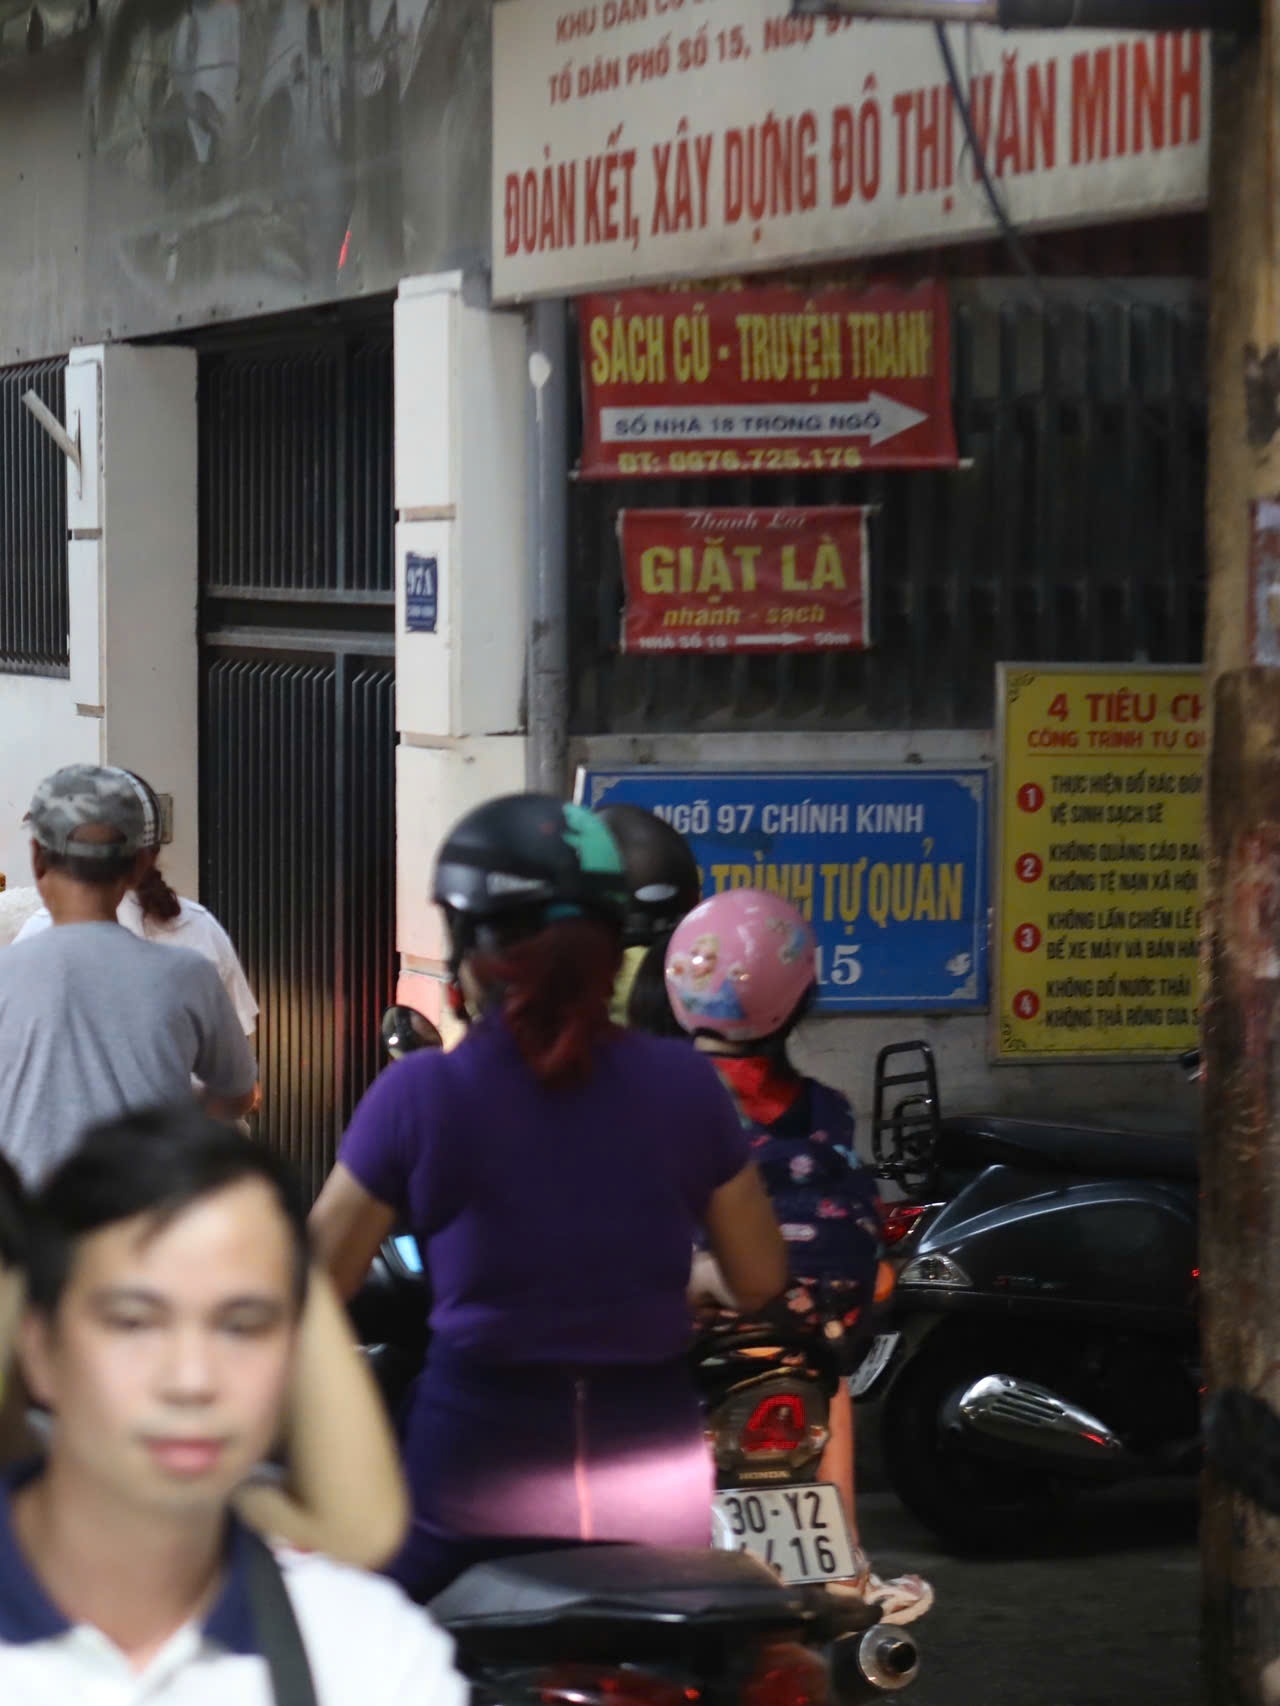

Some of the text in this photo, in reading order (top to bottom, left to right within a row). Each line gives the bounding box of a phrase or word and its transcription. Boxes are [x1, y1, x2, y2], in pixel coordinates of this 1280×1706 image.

[556, 5, 597, 43] KHU
[626, 29, 673, 85] PHỐ
[678, 18, 710, 70] SỐ
[584, 119, 641, 253] KẾT,
[651, 115, 714, 236] XÂY
[724, 109, 818, 245] DỰNG
[830, 71, 881, 210] ĐÔ
[892, 79, 955, 214] THỊ
[969, 48, 1057, 182] VĂN
[1070, 31, 1202, 167] MINH
[590, 301, 666, 385] SÁCH
[673, 302, 711, 384] CŨ
[735, 298, 842, 396] TRUYỆN
[616, 412, 648, 436] SỐ
[742, 414, 821, 433] TRONG
[829, 409, 882, 431] NGÕ
[640, 533, 847, 604] GIẶT LÀ
[663, 604, 742, 627] nhanh
[1048, 693, 1068, 722] 4
[1085, 686, 1157, 723] TIÊU
[1027, 728, 1079, 748] CÔNG
[1088, 728, 1144, 748] TRÌNH
[1025, 788, 1035, 808] 1
[653, 798, 924, 835] NGÕ 97 CHÍNH KINH
[1049, 840, 1096, 862] KHÔNG
[1149, 839, 1178, 862] CÁO
[1022, 857, 1036, 878] 2
[820, 857, 869, 935] TỰ
[869, 838, 964, 928] QUẢN
[1048, 870, 1095, 892] KHÔNG
[1048, 909, 1094, 930] KHÔNG
[1021, 927, 1034, 948] 3
[1068, 941, 1087, 959] XE
[1090, 938, 1121, 959] MÁY
[1046, 976, 1093, 998] KHÔNG
[1020, 995, 1034, 1015] 4
[1046, 1007, 1093, 1028] KHÔNG
[739, 1470, 792, 1481] HONDA
[725, 1490, 828, 1536] 30-Y2
